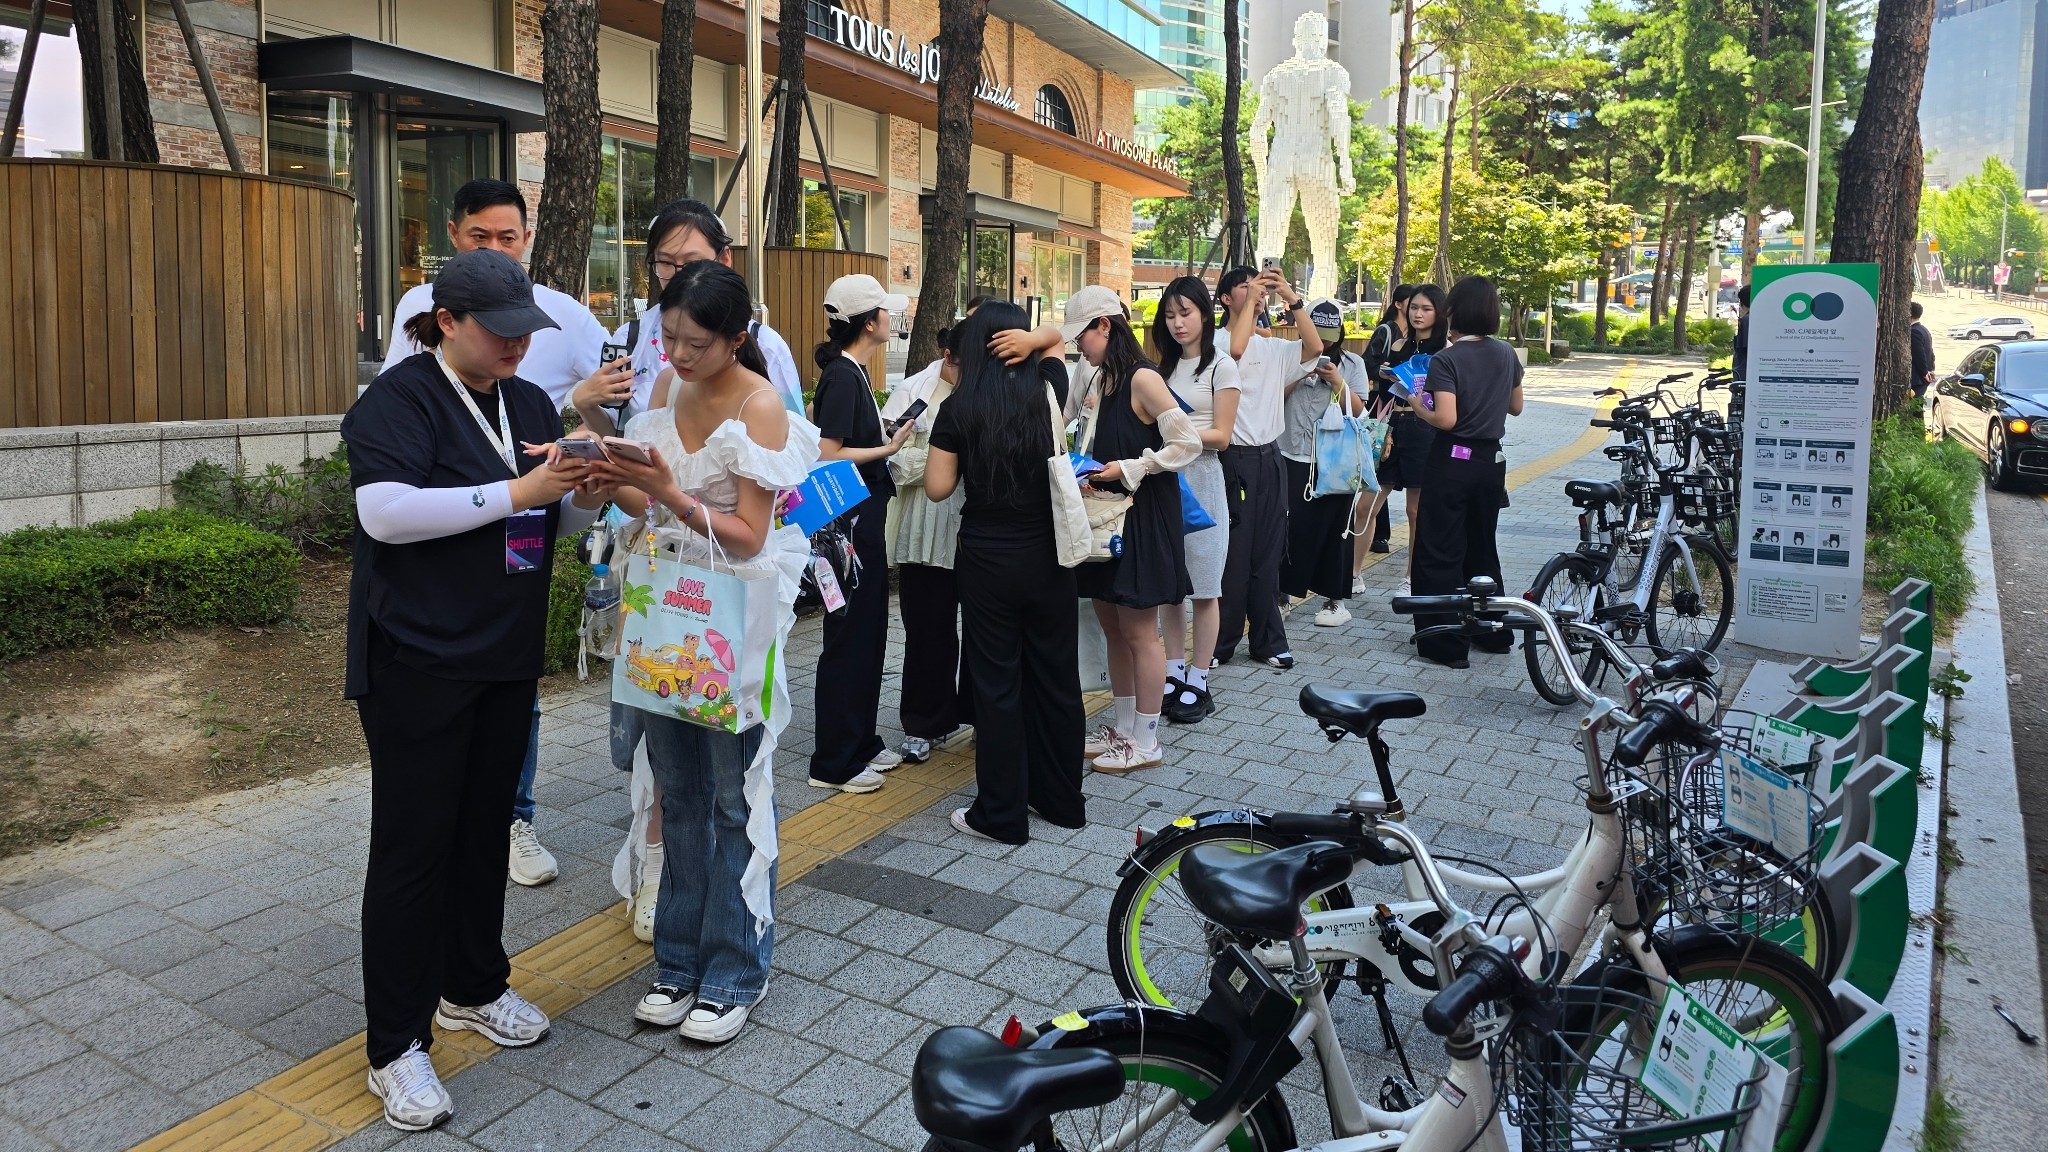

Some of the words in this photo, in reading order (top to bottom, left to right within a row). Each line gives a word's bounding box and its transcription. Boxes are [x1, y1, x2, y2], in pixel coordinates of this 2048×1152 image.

[830, 5, 894, 64] TOUS
[898, 35, 919, 73] les
[1097, 129, 1104, 147] A
[1105, 133, 1150, 166] TWOSOME
[1152, 152, 1179, 176] PLACE
[508, 537, 544, 550] SHUTTLE
[677, 576, 705, 598] LOVE
[663, 590, 713, 616] SUMMER
